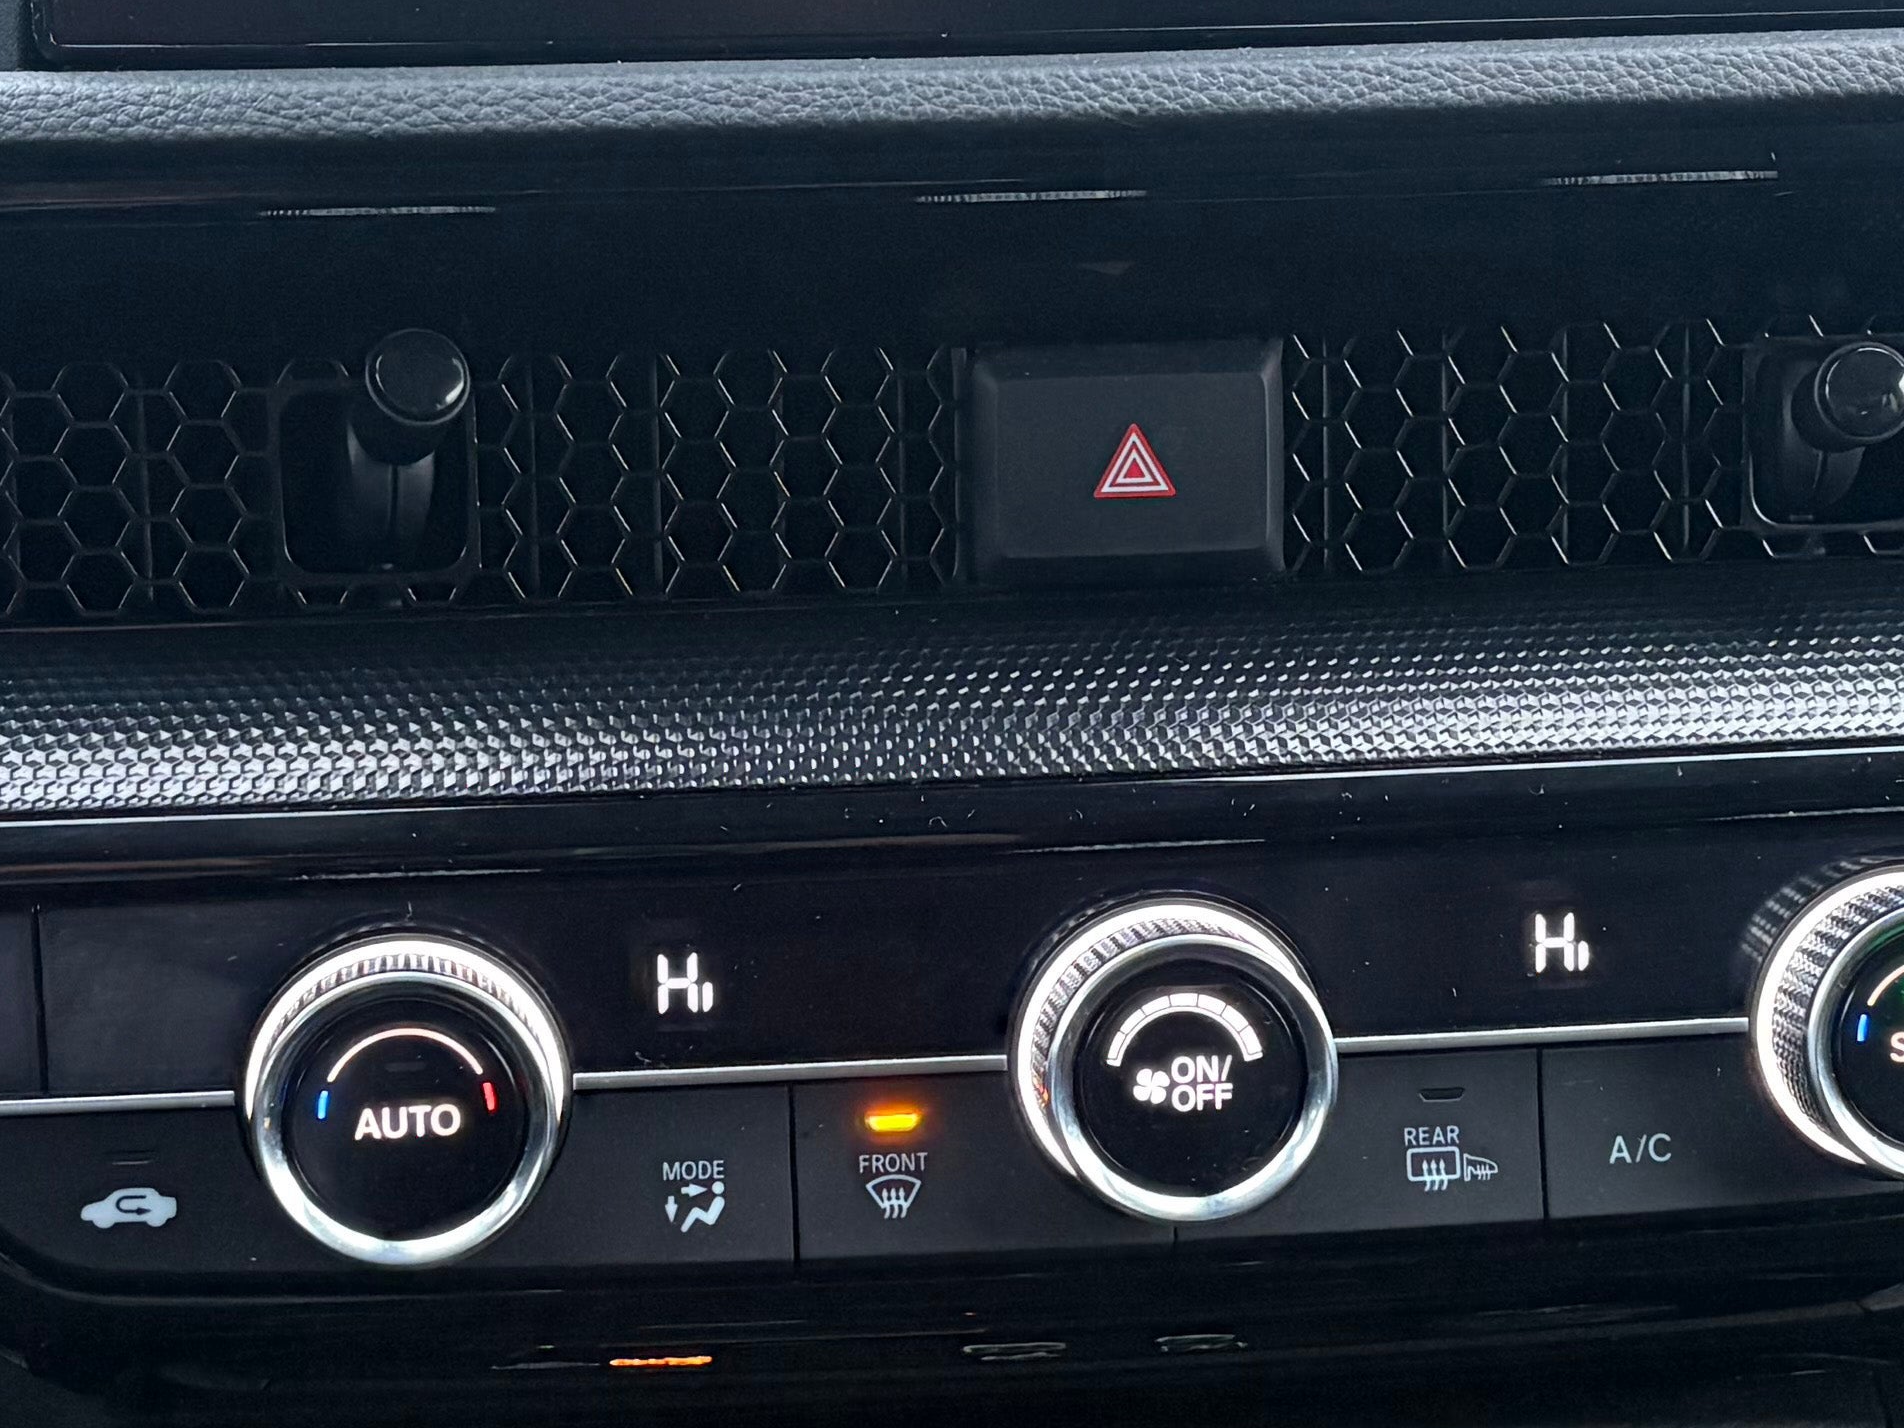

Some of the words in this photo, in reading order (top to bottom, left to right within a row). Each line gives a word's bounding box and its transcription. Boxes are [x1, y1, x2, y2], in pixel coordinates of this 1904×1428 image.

[1171, 1055, 1233, 1080] ON/
[1172, 1082, 1234, 1112] OFF
[354, 1103, 462, 1141] AUTO
[1404, 1126, 1460, 1146] REAR
[1609, 1133, 1672, 1165] A/C
[662, 1160, 725, 1181] MODE
[858, 1152, 928, 1174] FRONT
